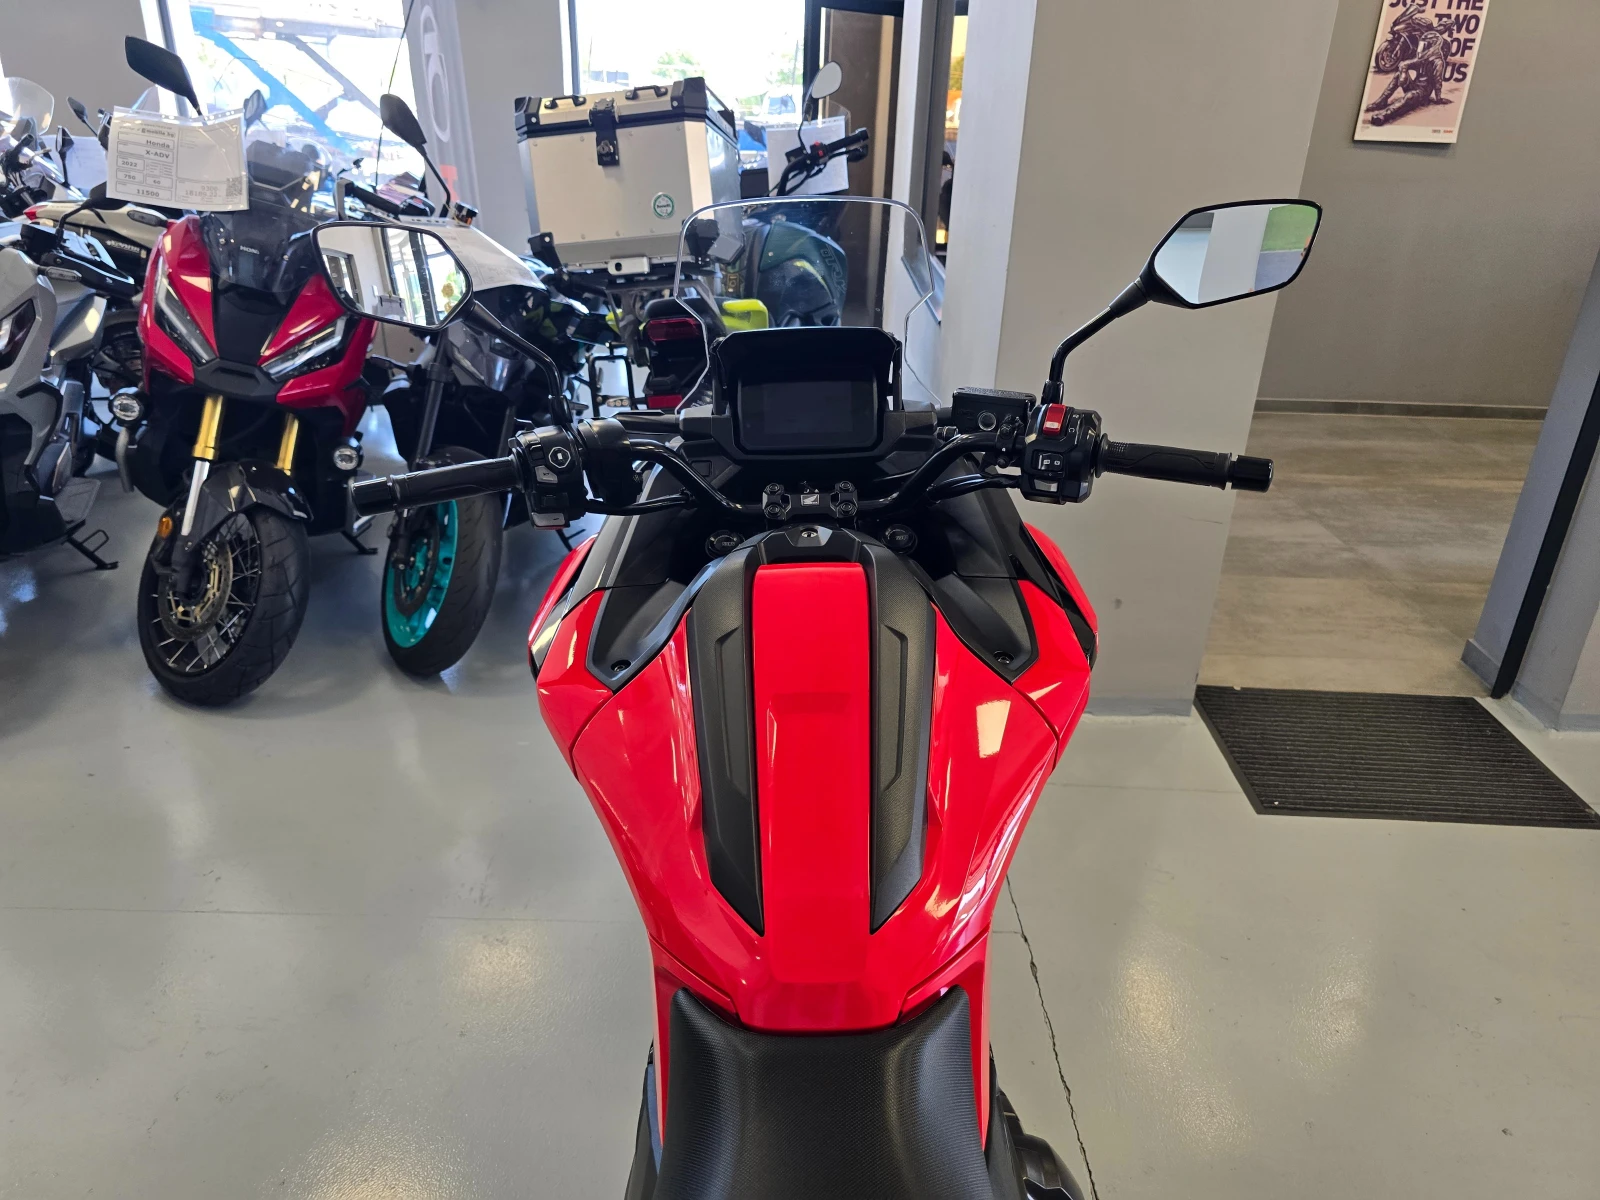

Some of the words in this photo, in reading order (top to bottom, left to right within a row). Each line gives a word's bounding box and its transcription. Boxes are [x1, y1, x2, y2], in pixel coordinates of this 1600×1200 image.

[1434, 13, 1480, 34] TWO
[1448, 38, 1476, 58] OF
[1443, 63, 1469, 82] US
[146, 139, 170, 149] Honda
[145, 149, 170, 159] X-ADV
[136, 188, 160, 197] 11500
